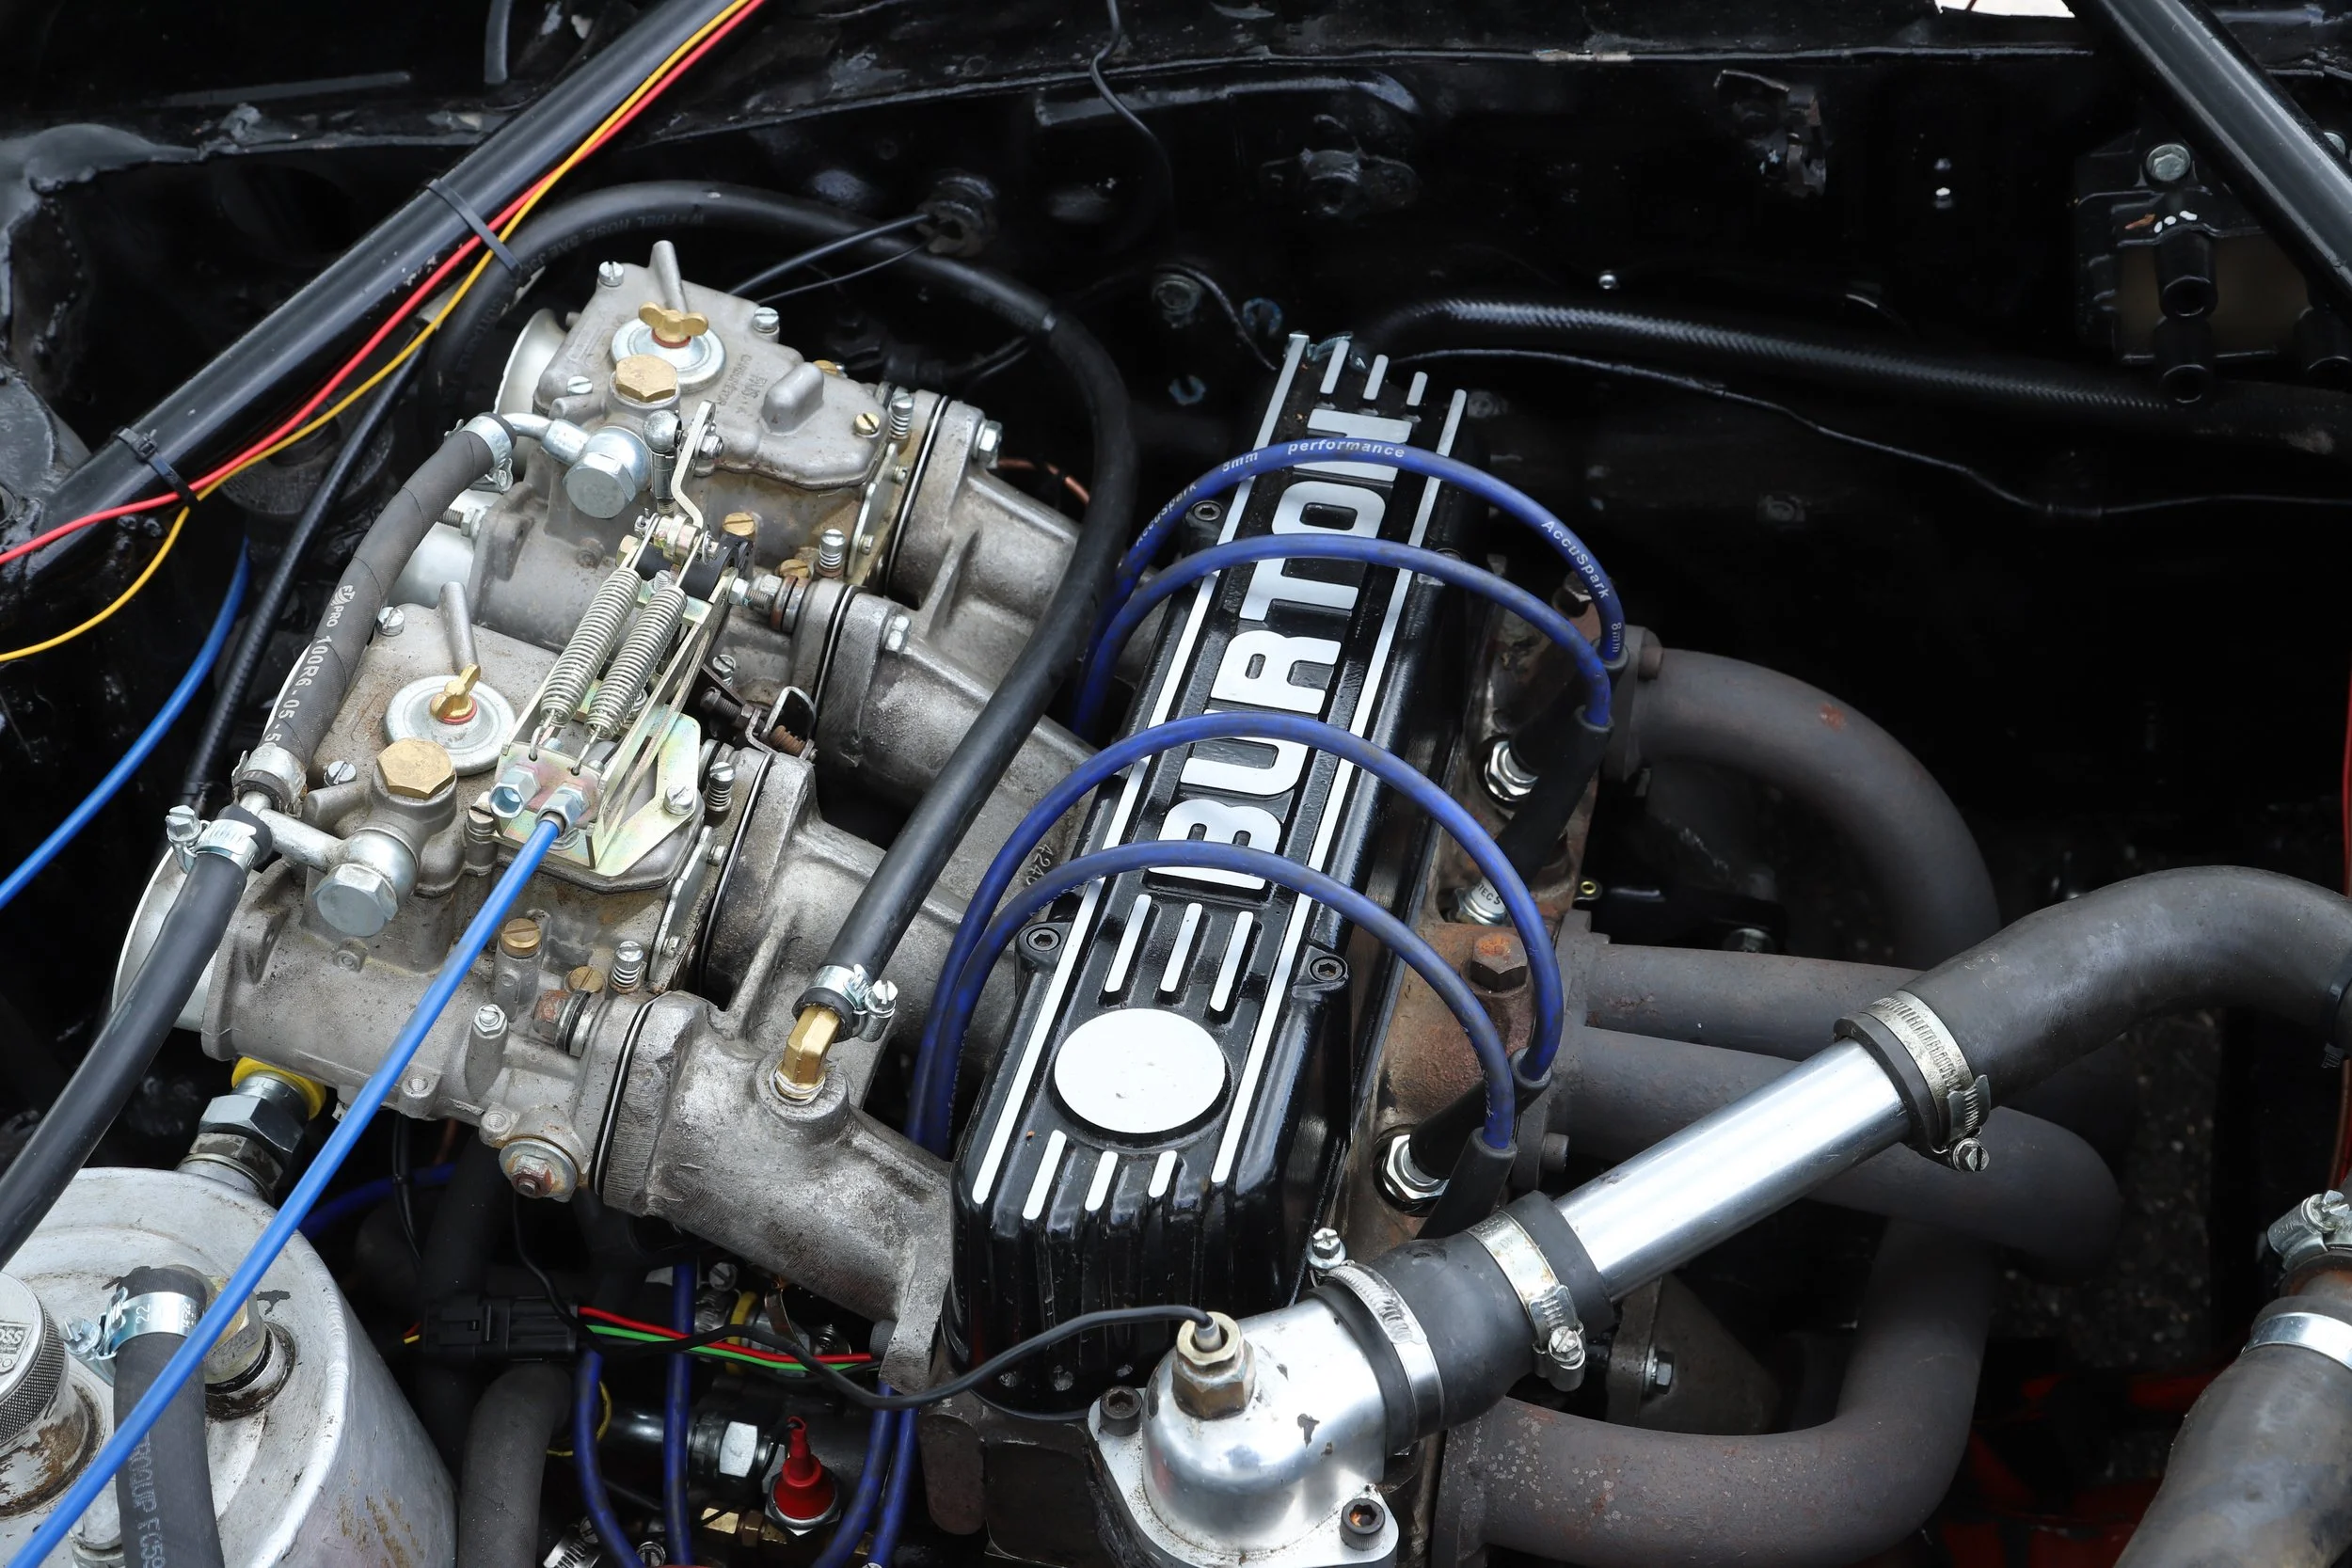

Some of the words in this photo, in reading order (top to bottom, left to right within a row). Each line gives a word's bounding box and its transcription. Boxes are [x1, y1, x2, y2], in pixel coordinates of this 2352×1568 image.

[1288, 439, 1405, 459] performance
[1540, 519, 1611, 600] AccuSpark
[326, 605, 345, 628] PRO
[294, 634, 333, 688] 100R6
[1148, 408, 1413, 890] BURTON
[135, 1303, 151, 1325] 22
